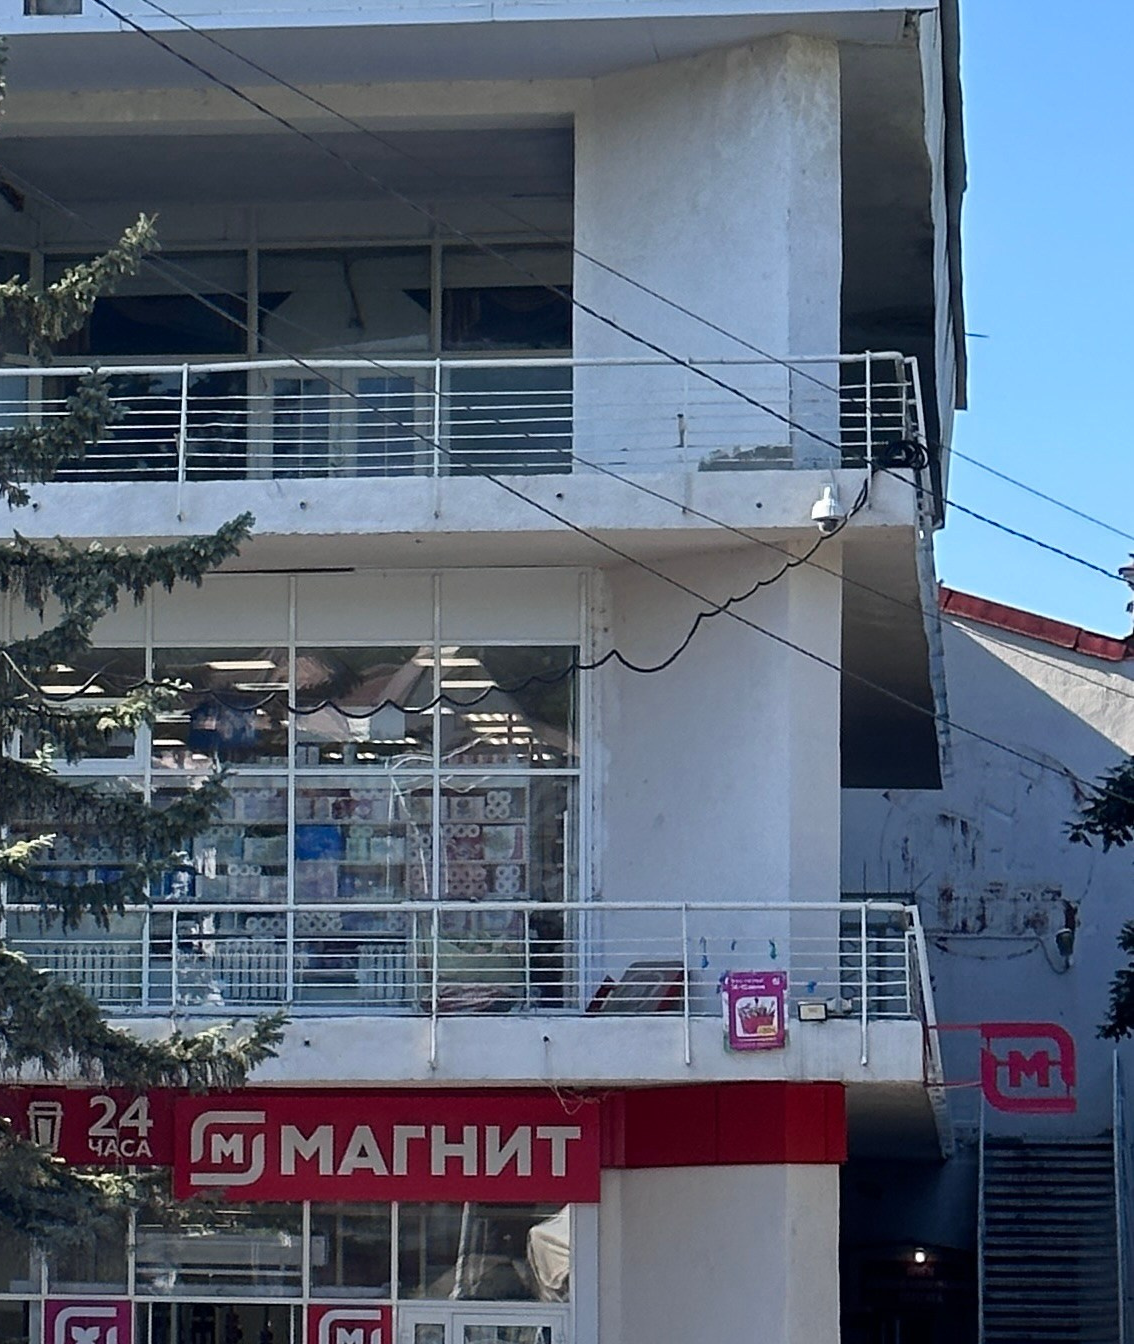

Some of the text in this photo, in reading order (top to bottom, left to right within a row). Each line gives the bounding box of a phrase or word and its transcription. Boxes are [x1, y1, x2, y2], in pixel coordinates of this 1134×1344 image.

[88, 1095, 154, 1136] 24
[88, 1138, 153, 1158] ЧАСА
[280, 1125, 581, 1177] МАГНИТ
